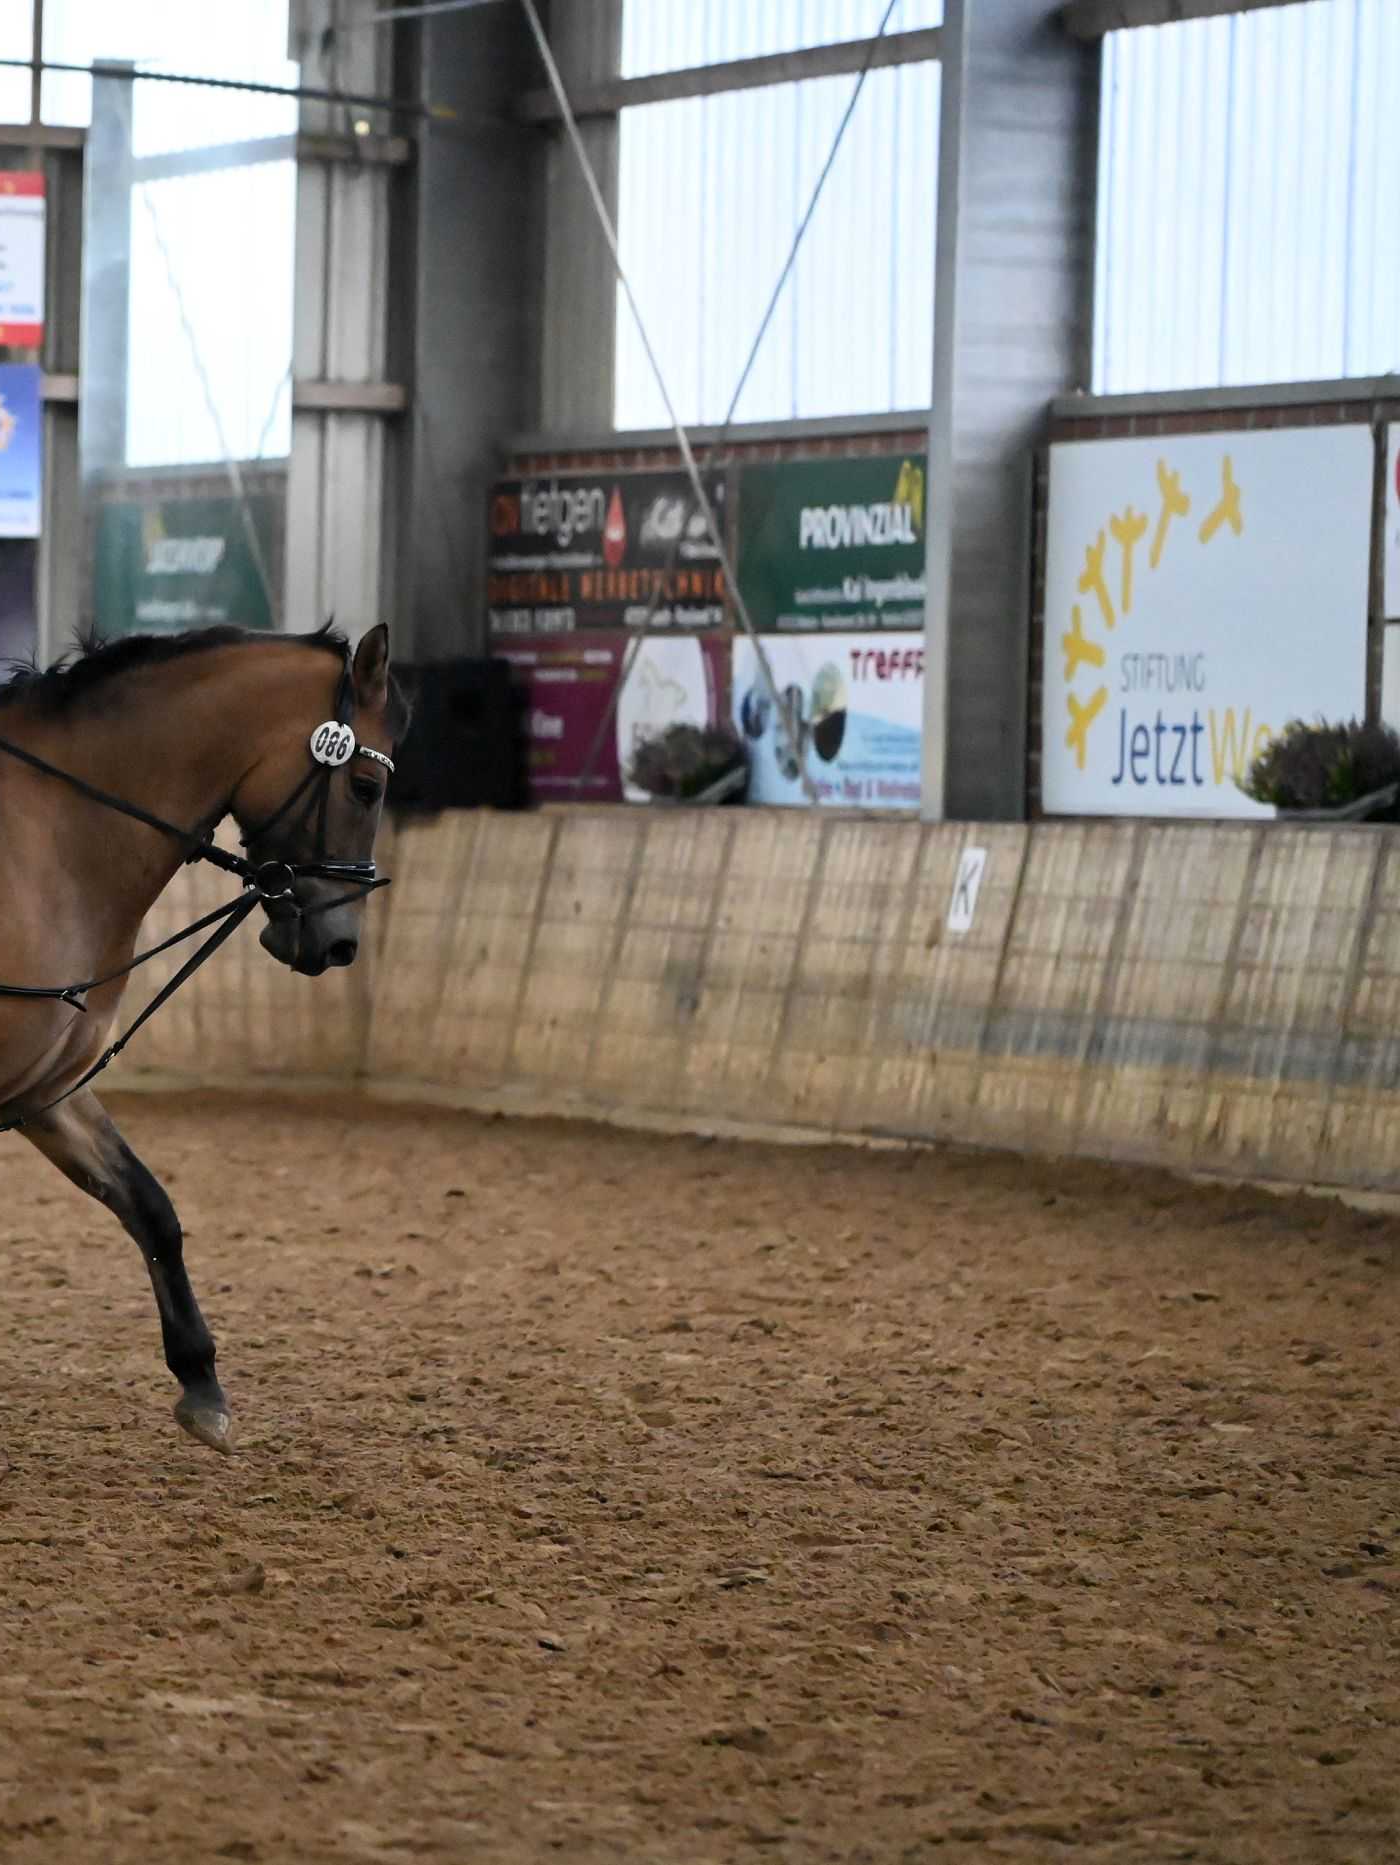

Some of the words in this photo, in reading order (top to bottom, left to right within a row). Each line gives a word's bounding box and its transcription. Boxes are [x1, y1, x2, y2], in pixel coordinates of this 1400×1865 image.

[799, 504, 917, 549] PROVINZIAL
[1120, 652, 1205, 692] STIFTUNG
[315, 726, 351, 760] 086
